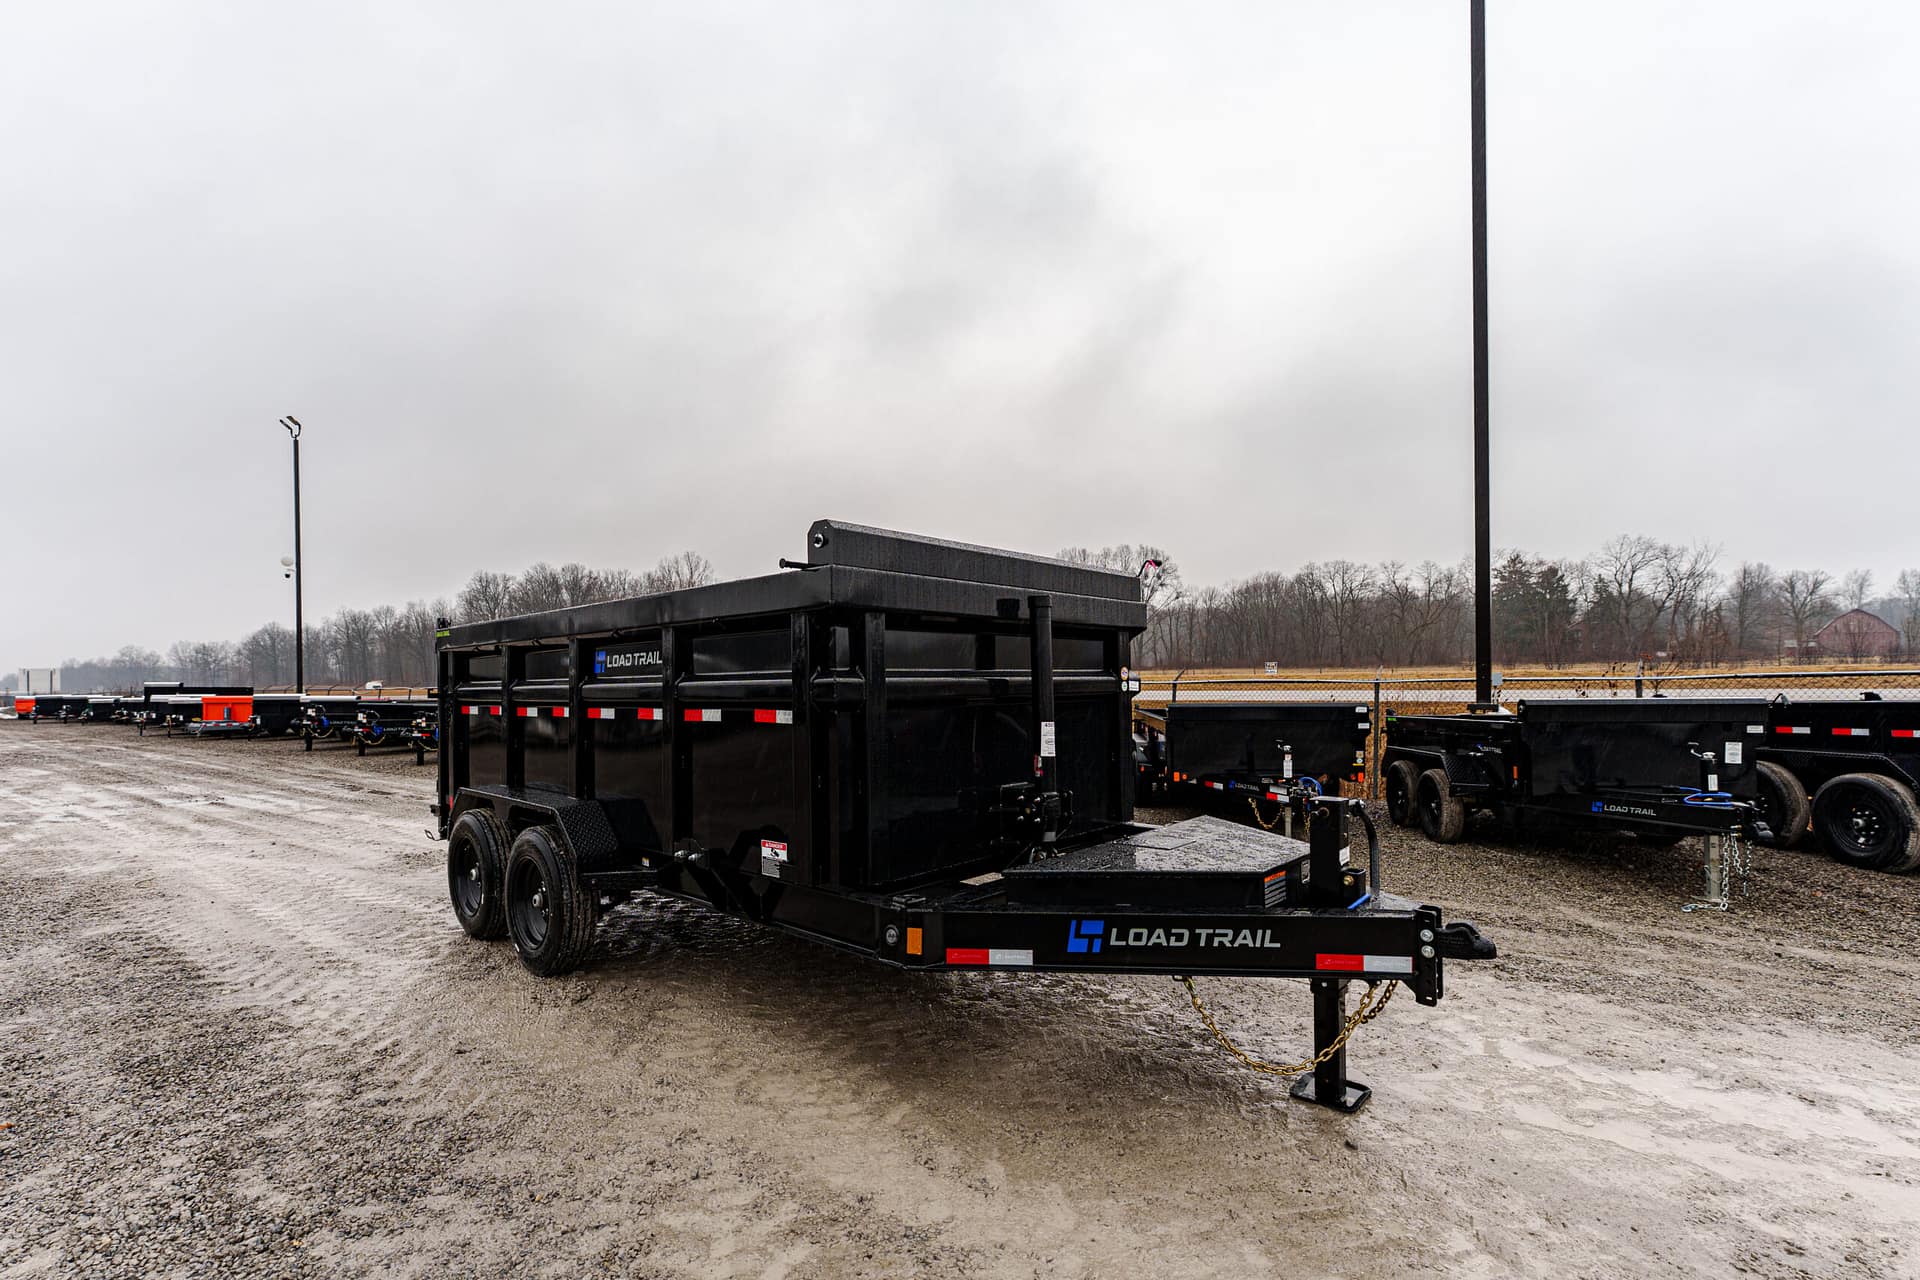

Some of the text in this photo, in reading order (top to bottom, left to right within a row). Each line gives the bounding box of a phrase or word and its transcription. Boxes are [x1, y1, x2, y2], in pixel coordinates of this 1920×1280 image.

[606, 650, 663, 668] LOAD TRAIL
[1603, 804, 1657, 817] LOAD TRAIL
[1109, 927, 1281, 948] LOAD TRAIL
